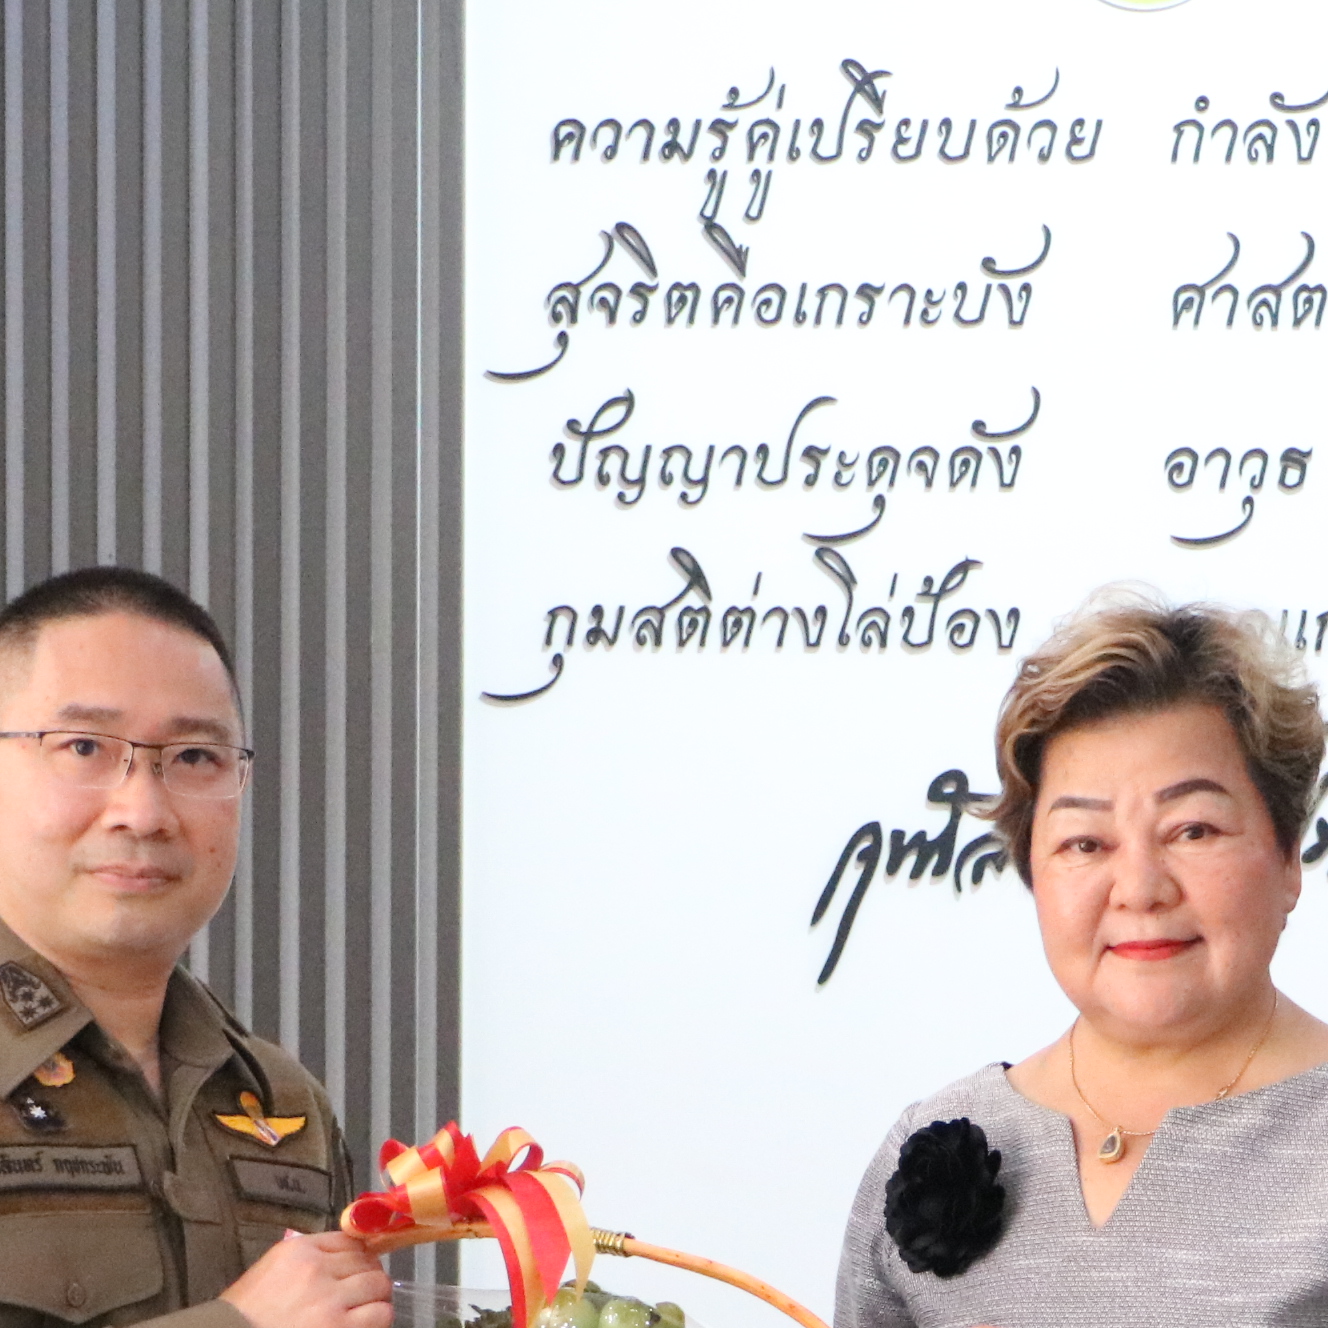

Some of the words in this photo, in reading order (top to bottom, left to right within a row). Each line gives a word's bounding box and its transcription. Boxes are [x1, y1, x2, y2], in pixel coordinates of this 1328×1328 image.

[550, 58, 1103, 222] ความรู้คู่เปรียบด้วย
[486, 221, 1052, 383] สุจริตคือเกราะบัง
[550, 386, 1041, 542] ปัญญาประดุจดัง
[1163, 445, 1313, 547] อาวุธ
[481, 546, 1021, 704] กุมสติต่างโล่ป้อง
